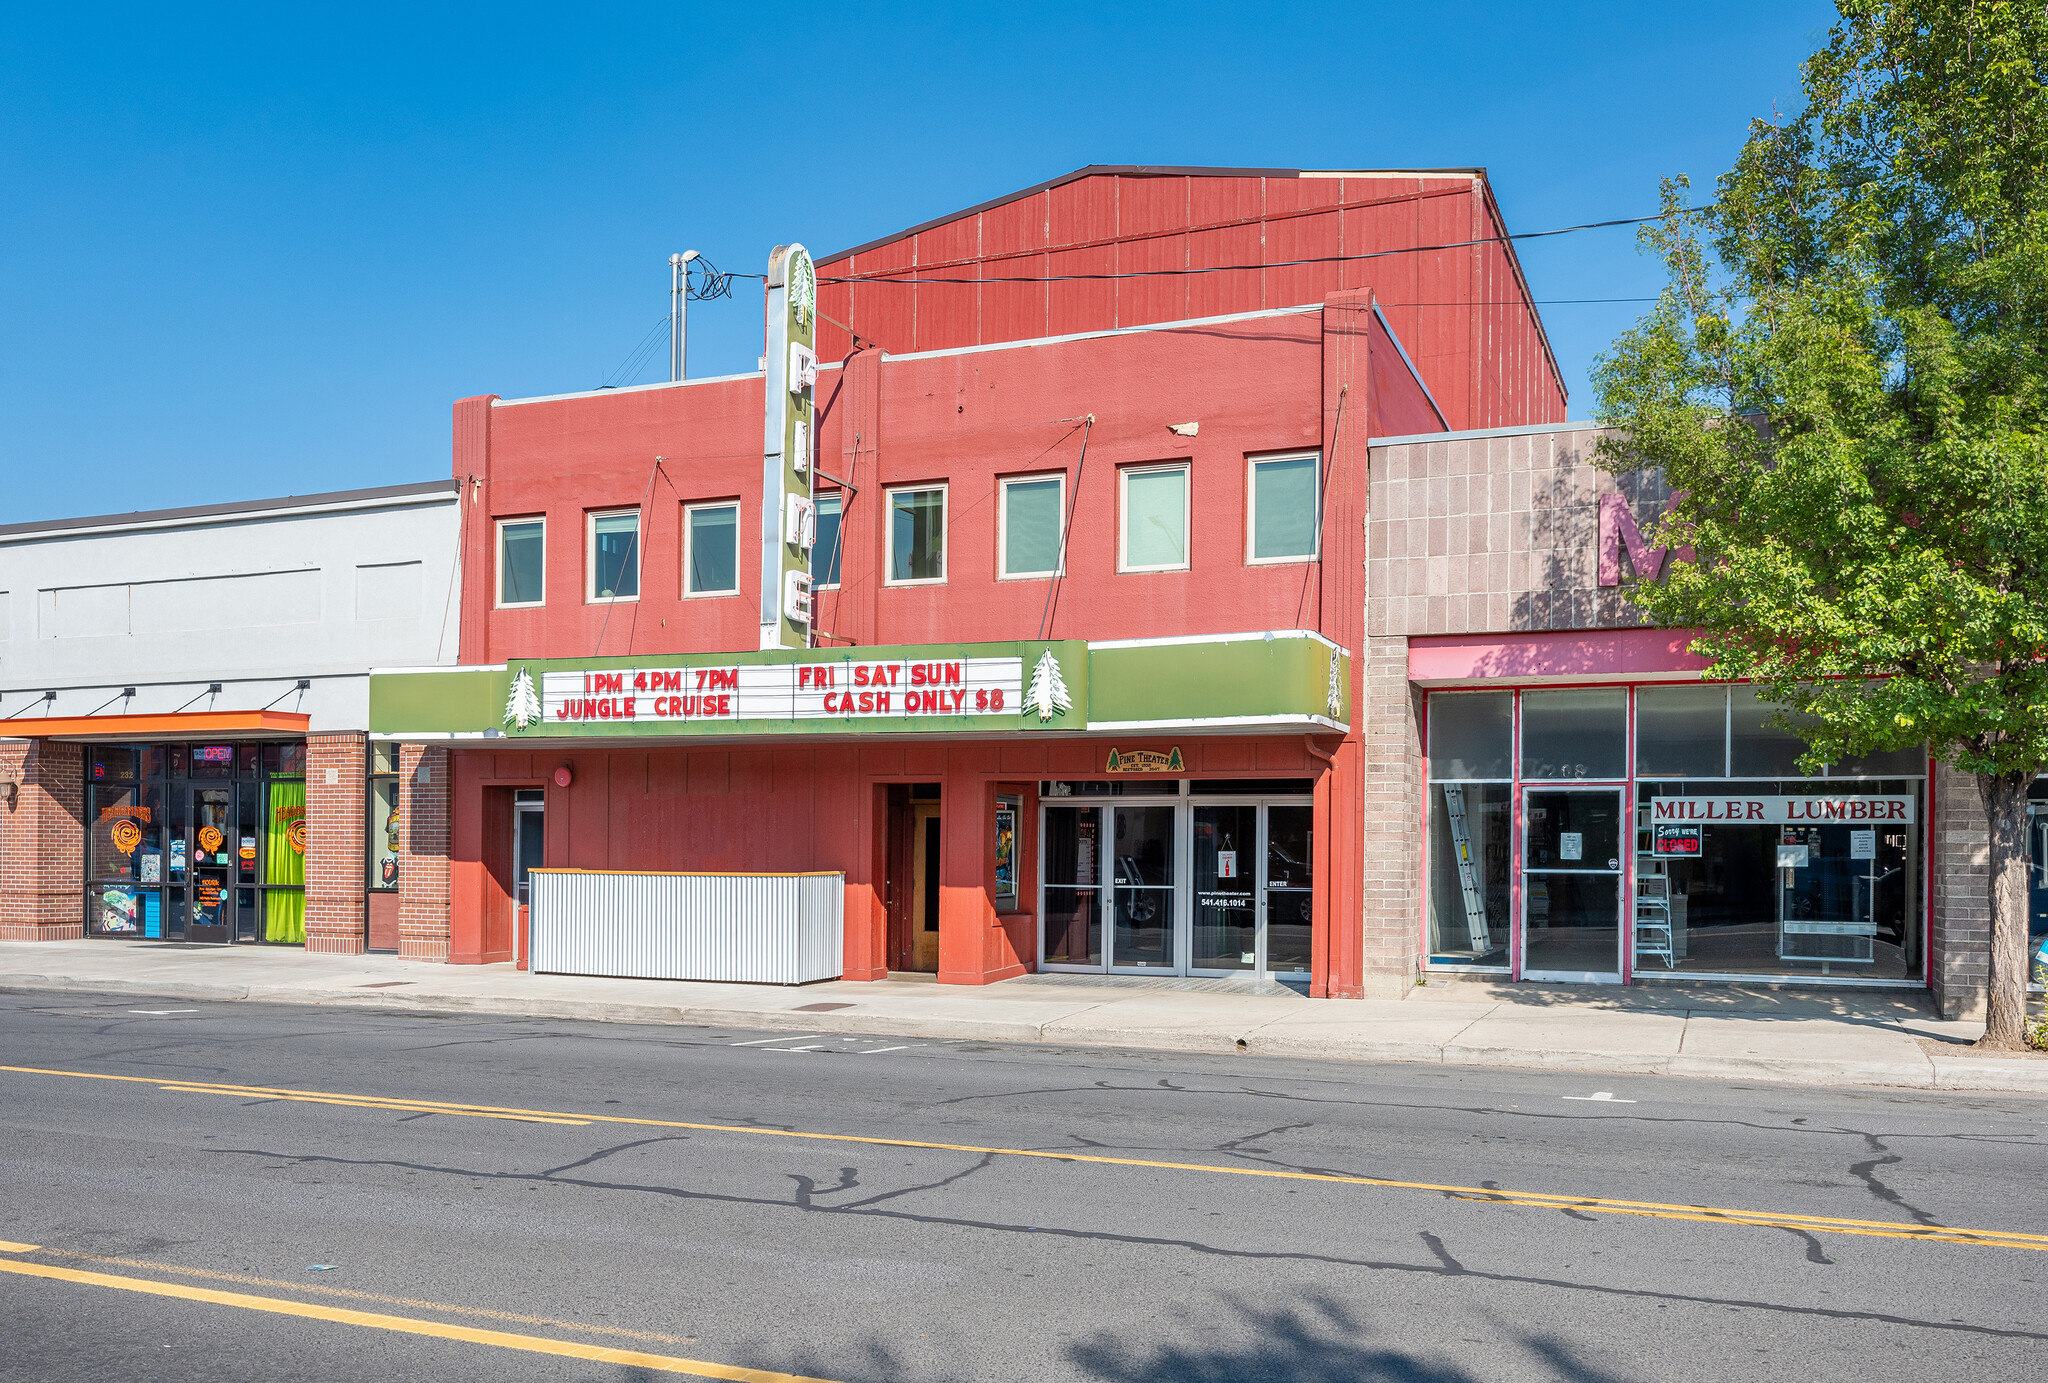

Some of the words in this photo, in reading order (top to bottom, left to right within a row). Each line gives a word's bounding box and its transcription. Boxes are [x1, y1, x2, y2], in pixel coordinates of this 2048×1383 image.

[585, 673, 623, 695] 1PM
[634, 671, 681, 692] 4PM
[696, 669, 738, 692] 7PM
[800, 666, 834, 690] FRI
[854, 665, 900, 687] SAT
[911, 663, 960, 687] SUN
[557, 697, 636, 720] JUNGLE
[655, 695, 730, 717] CRUISE
[824, 692, 890, 714] CASH
[905, 689, 966, 714] ONLY
[976, 688, 1004, 713] $8
[205, 748, 230, 759] OPEN
[1119, 755, 1135, 764] PINE
[120, 771, 133, 779] 232
[1654, 801, 1765, 819] MILLER
[1787, 800, 1907, 819] LUMBER
[1658, 826, 1680, 838] Sorry
[1656, 839, 1698, 852] CLOSED
[1201, 898, 1246, 907] 541.416.1014
